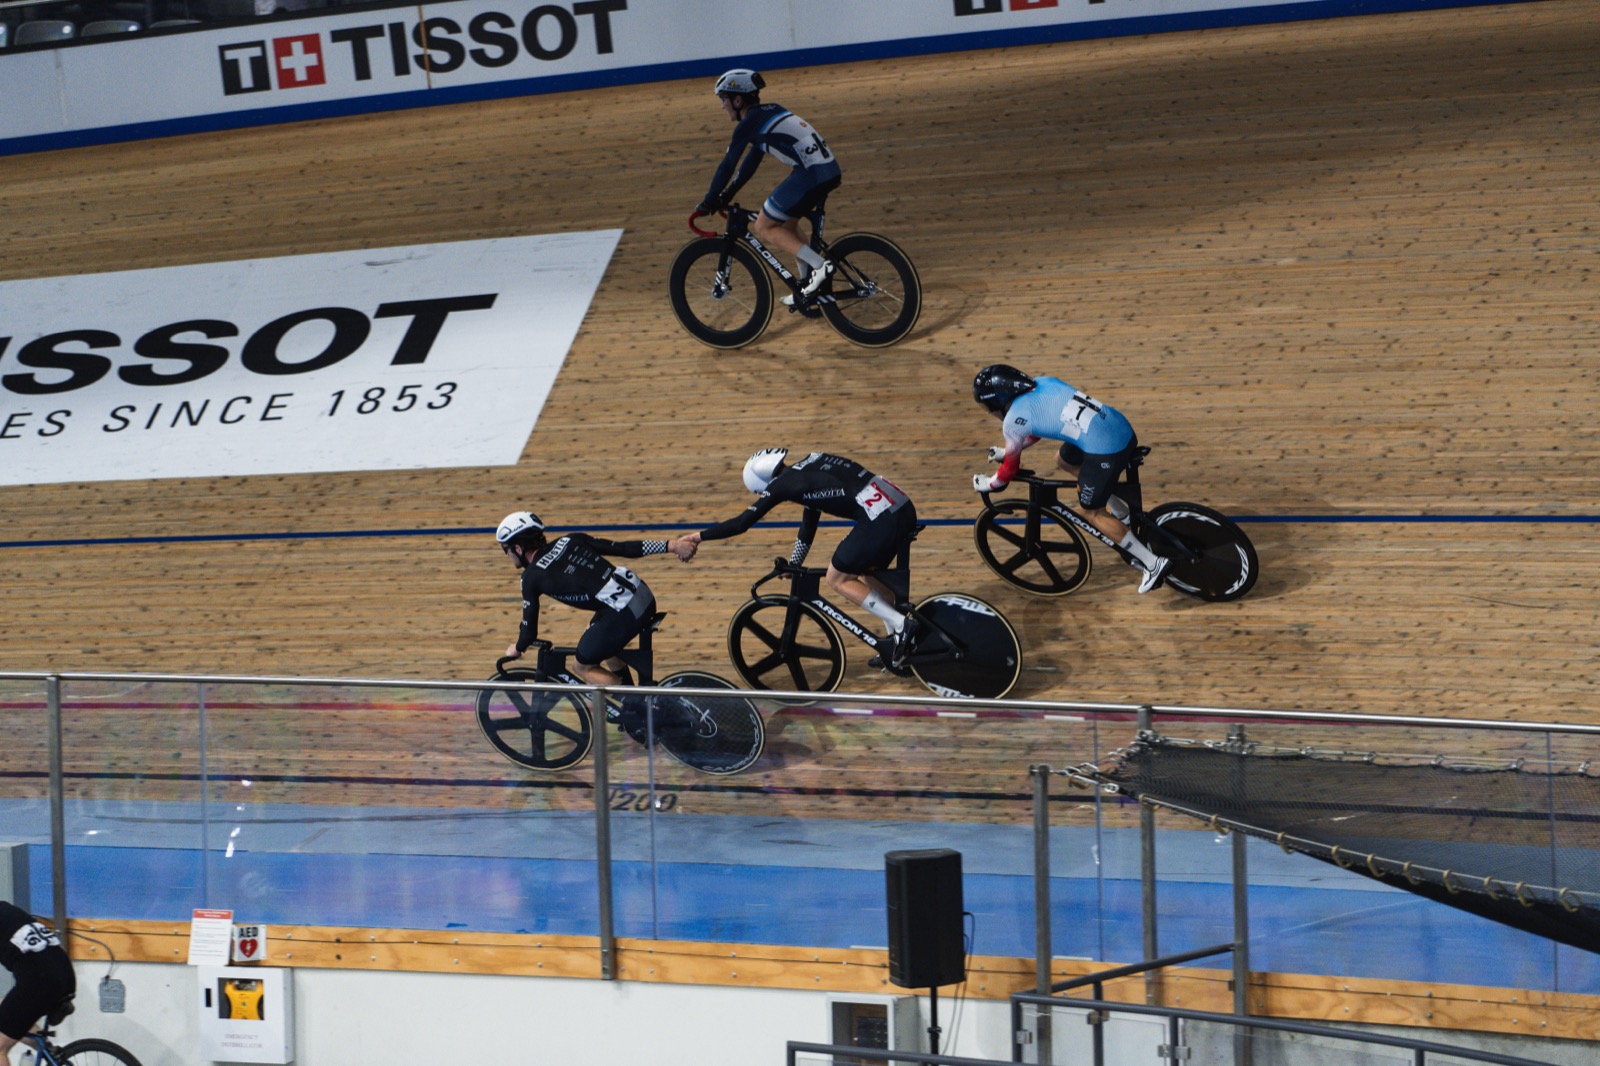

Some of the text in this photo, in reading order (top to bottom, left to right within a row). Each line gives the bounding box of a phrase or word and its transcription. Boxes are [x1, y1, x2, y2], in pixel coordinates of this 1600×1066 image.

[330, 0, 628, 82] TISSOT
[804, 143, 819, 155] 3
[744, 232, 792, 280] VELOBIKE
[102, 392, 294, 432] SINCE
[328, 382, 458, 417] 1853
[1075, 404, 1087, 421] 1
[803, 487, 846, 500] MAGNOTTA
[865, 492, 883, 508] 2
[1051, 505, 1105, 537] ARGON
[537, 537, 571, 569] HUSTLE
[609, 586, 625, 601] 2
[811, 599, 878, 647] ARGON 18
[238, 926, 259, 939] AED
